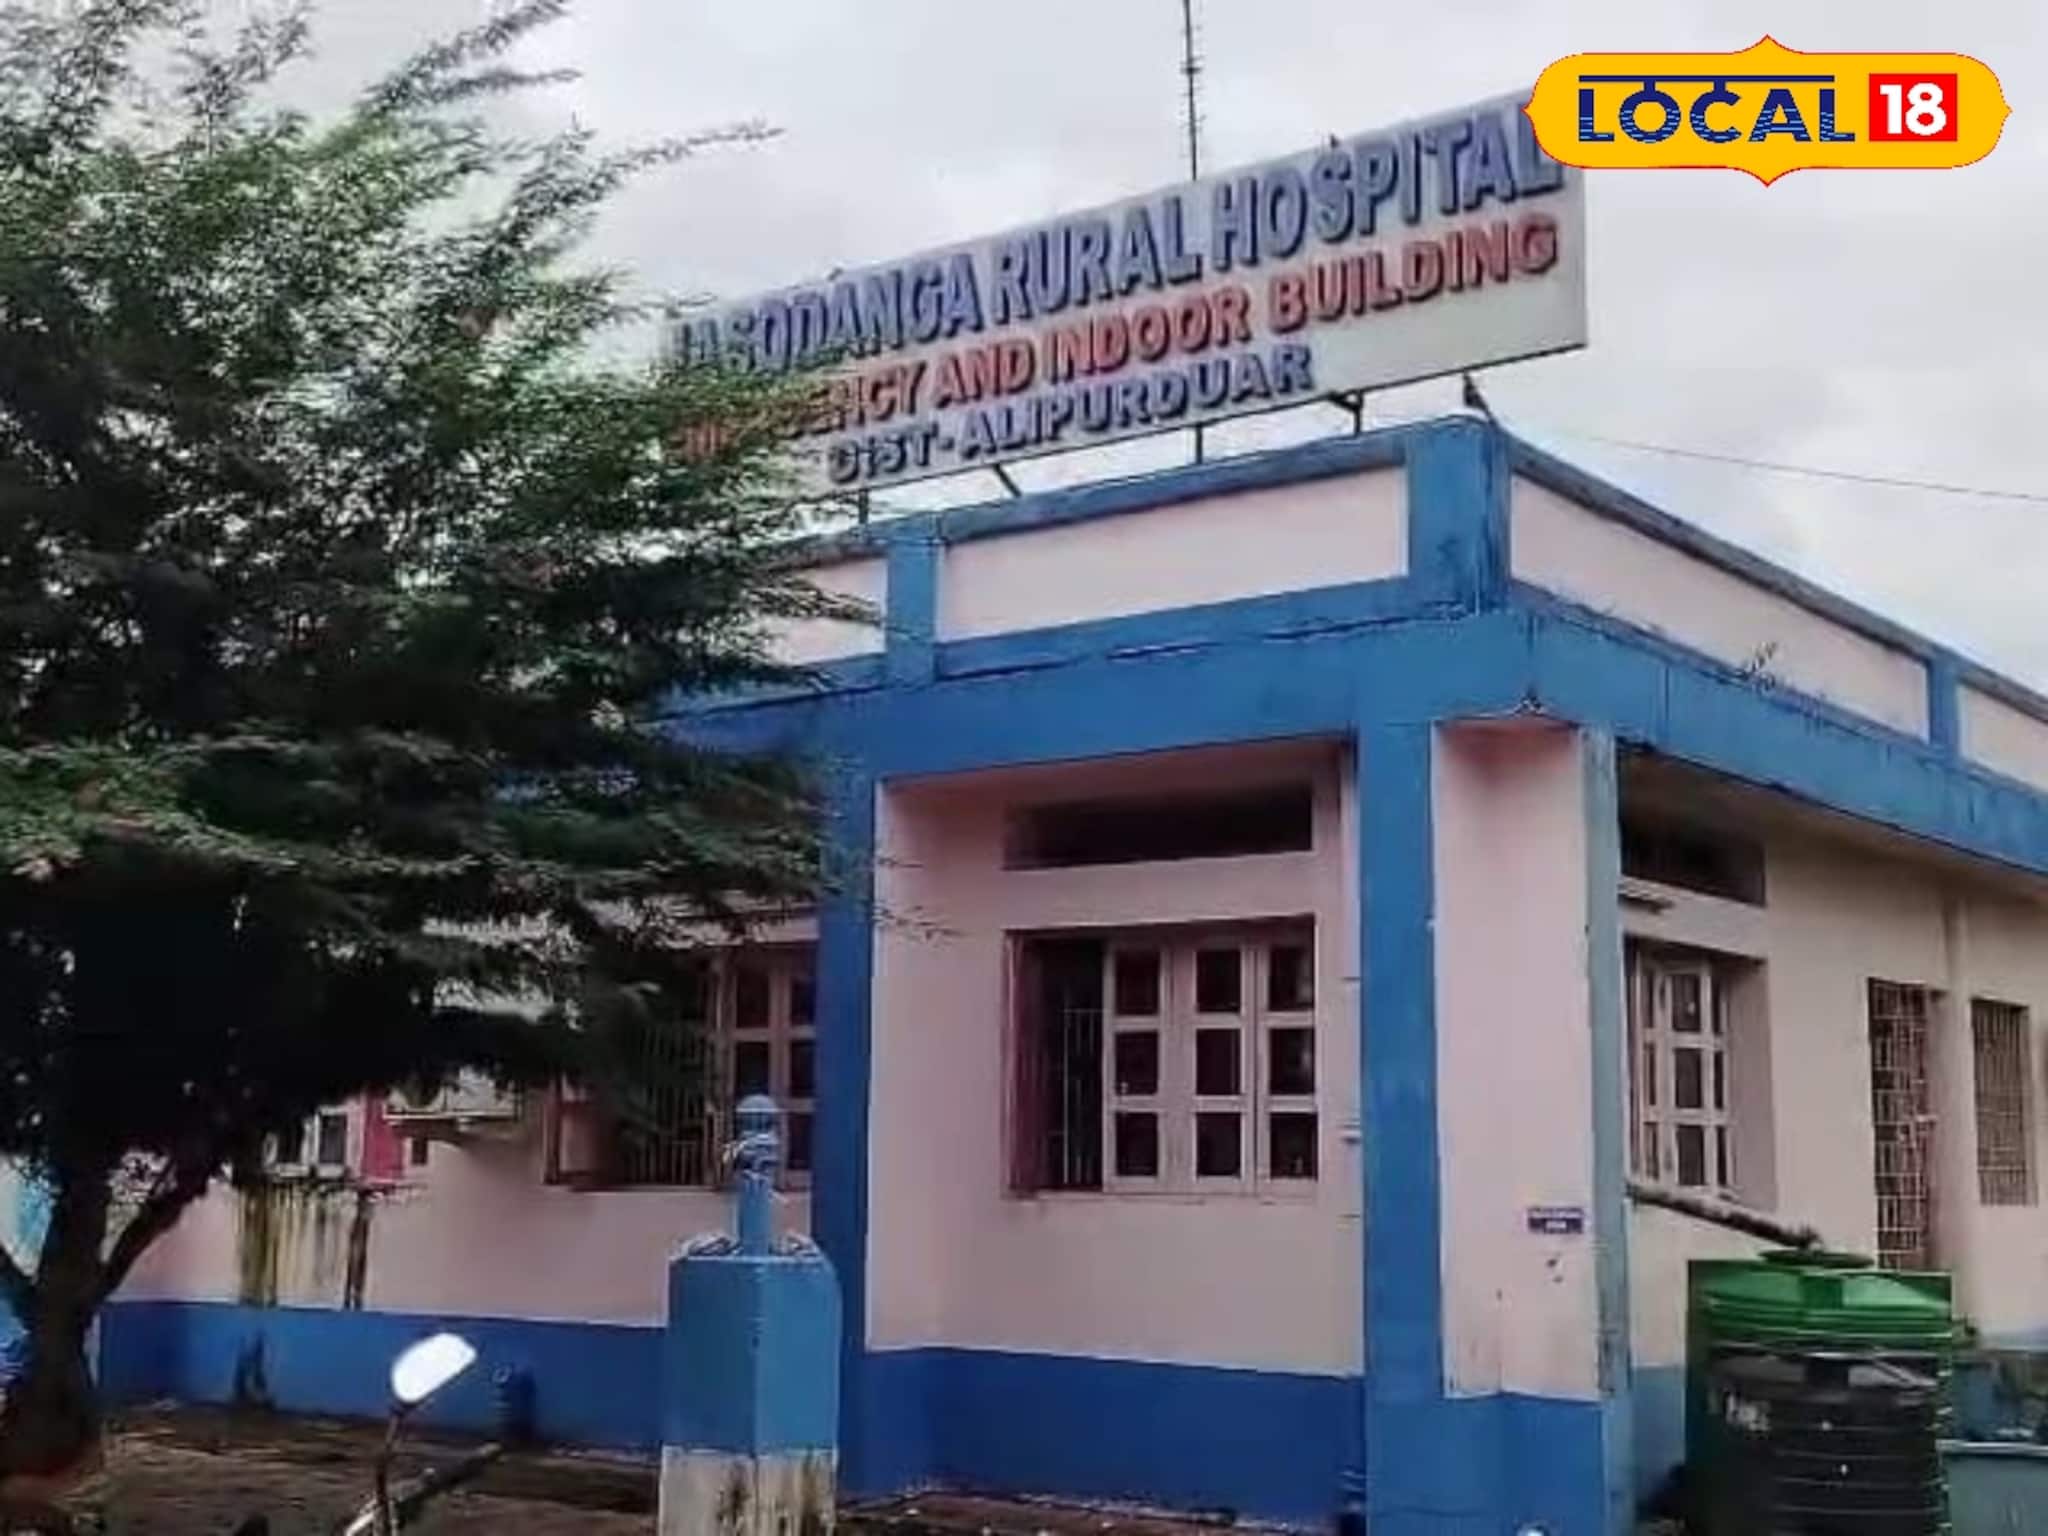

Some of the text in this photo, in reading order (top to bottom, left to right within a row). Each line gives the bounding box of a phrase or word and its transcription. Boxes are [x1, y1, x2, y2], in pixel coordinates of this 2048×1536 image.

[934, 338, 1038, 410] AND
[1046, 284, 1250, 385] INDOOR
[1268, 210, 1558, 334] BUILDING
[994, 202, 1200, 326] RURAL
[1212, 104, 1564, 273] HOSPITAL
